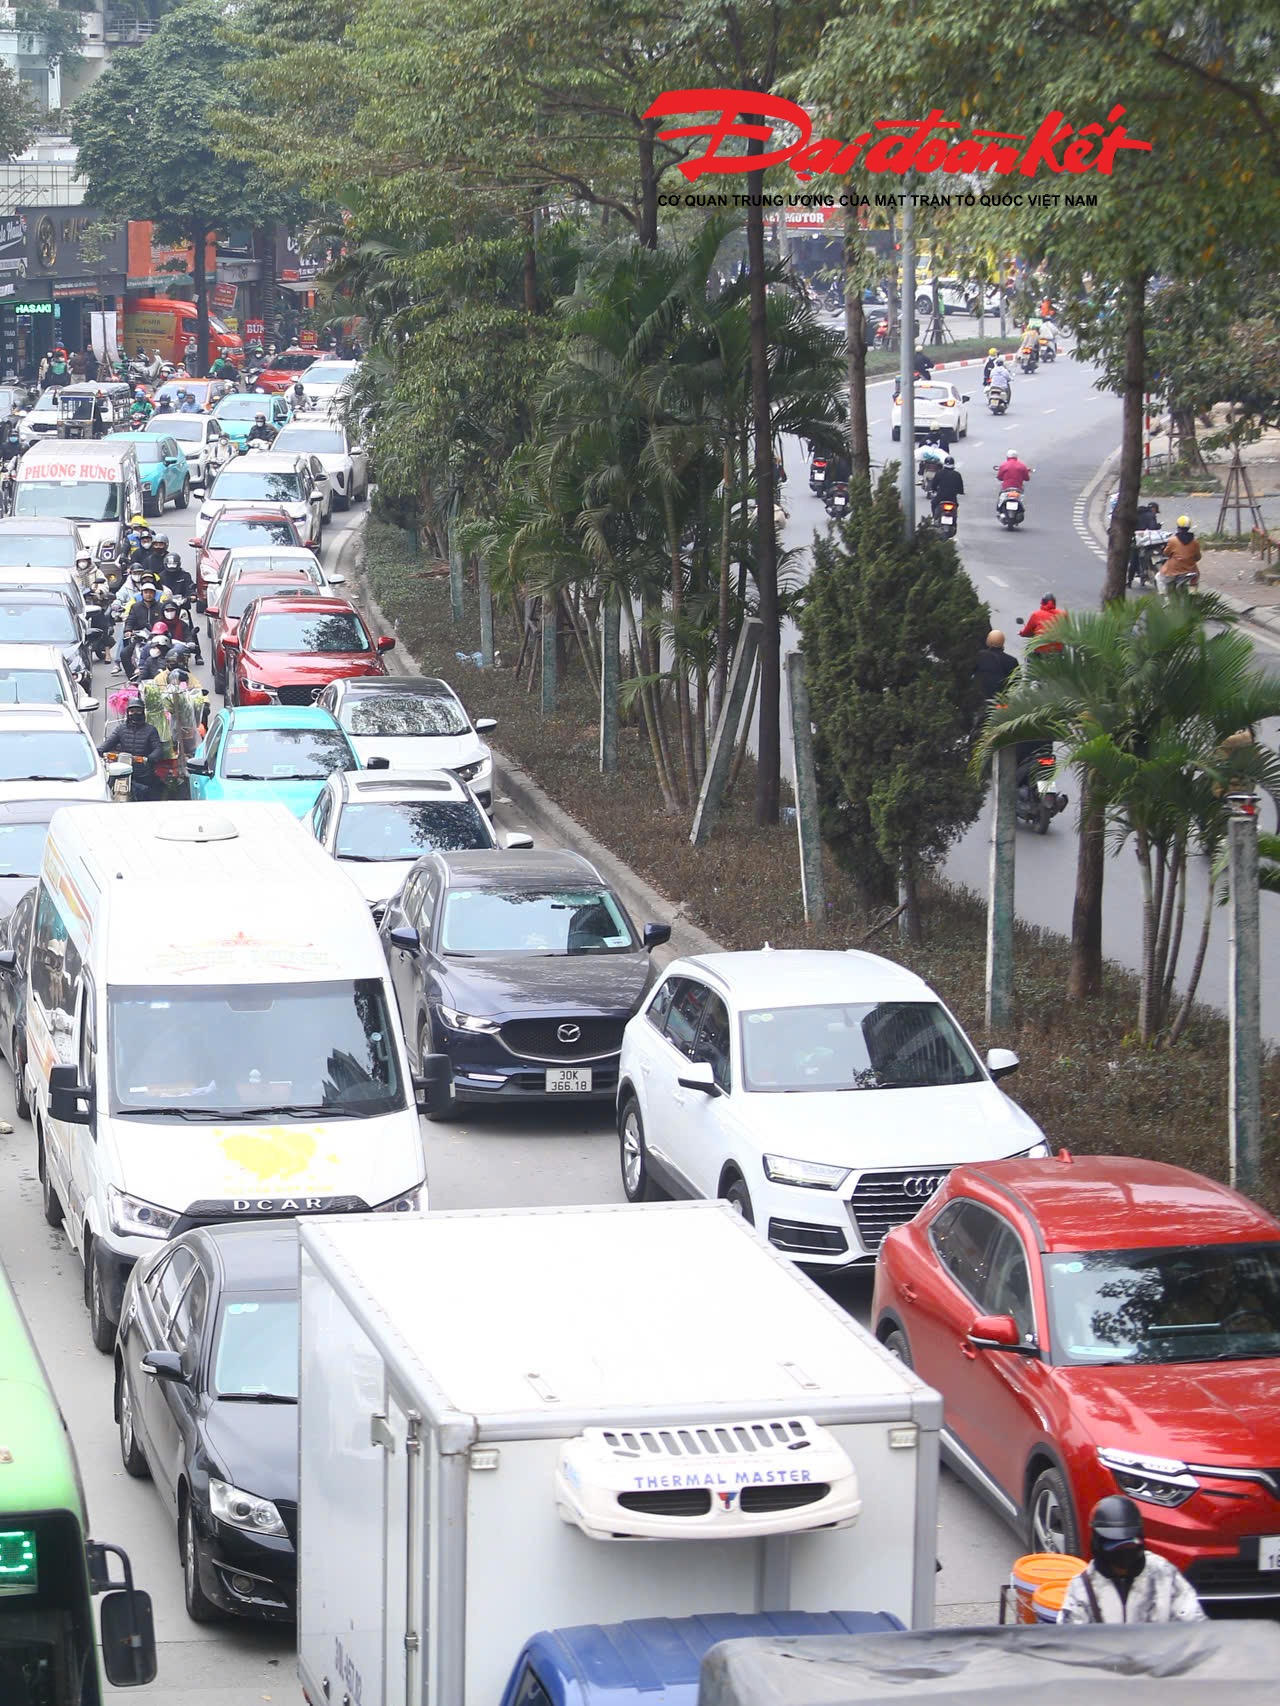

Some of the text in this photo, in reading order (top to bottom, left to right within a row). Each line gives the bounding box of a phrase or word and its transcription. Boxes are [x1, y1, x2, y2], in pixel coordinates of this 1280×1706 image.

[15, 303, 52, 314] HASAKI
[559, 1070, 579, 1081] 30K
[551, 1080, 587, 1092] 366.18
[233, 1198, 322, 1211] DCAR
[634, 1469, 812, 1489] THERMAL MASTER
